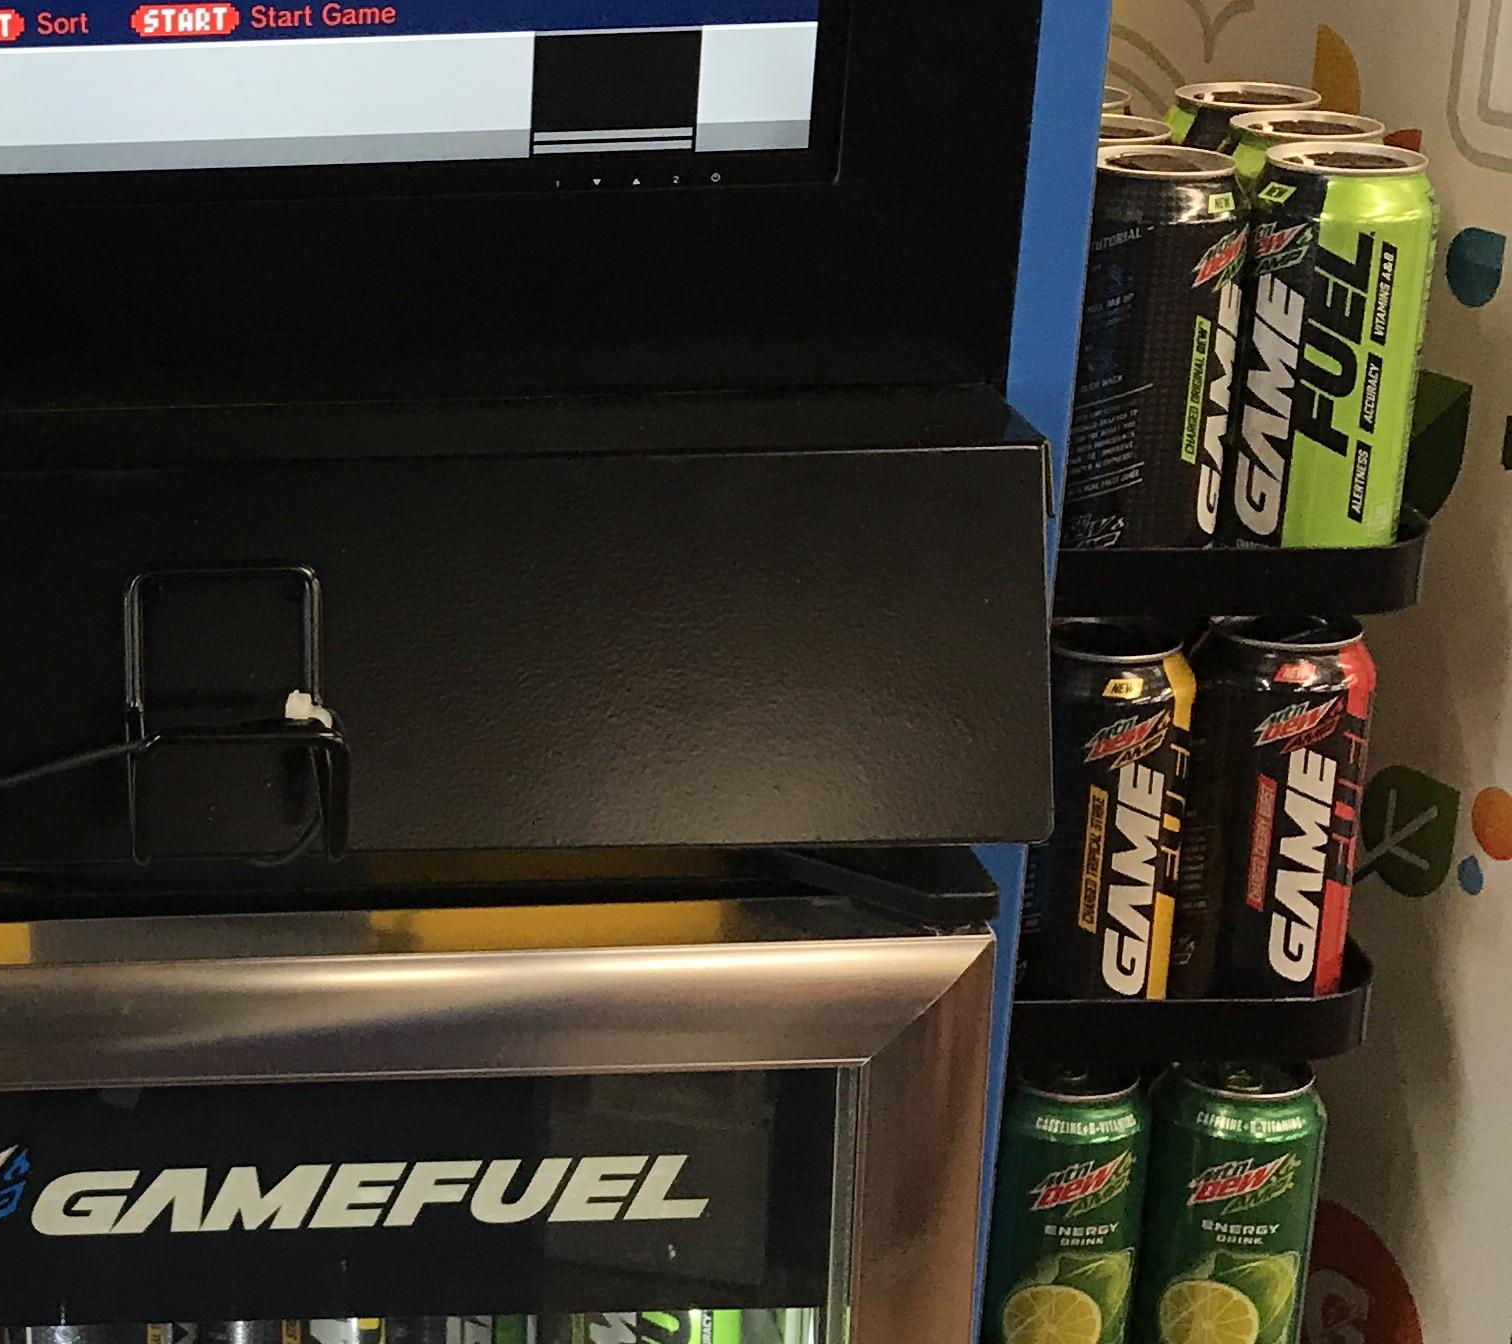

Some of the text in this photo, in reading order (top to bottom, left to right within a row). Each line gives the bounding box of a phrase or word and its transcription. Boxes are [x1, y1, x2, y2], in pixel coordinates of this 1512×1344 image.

[36, 11, 90, 36] Sort
[142, 6, 236, 35] START
[250, 2, 397, 30] Start Game
[1295, 231, 1376, 457] FUEL
[1190, 358, 1205, 404] ORIGINAL
[1351, 251, 1394, 514] ALERTNESS ACCURACY VITAMINS A&B
[1235, 273, 1306, 536] GAME
[1184, 406, 1199, 455] CHARGED
[1102, 761, 1165, 996] GAME
[1268, 748, 1337, 983] GAME
[31, 1154, 712, 1236] GAMEFUEL
[1044, 1222, 1120, 1237] ENERGY
[1060, 1236, 1105, 1246] DRINK
[1201, 1219, 1281, 1235] ENERGY
[1215, 1234, 1264, 1245] DRINK
